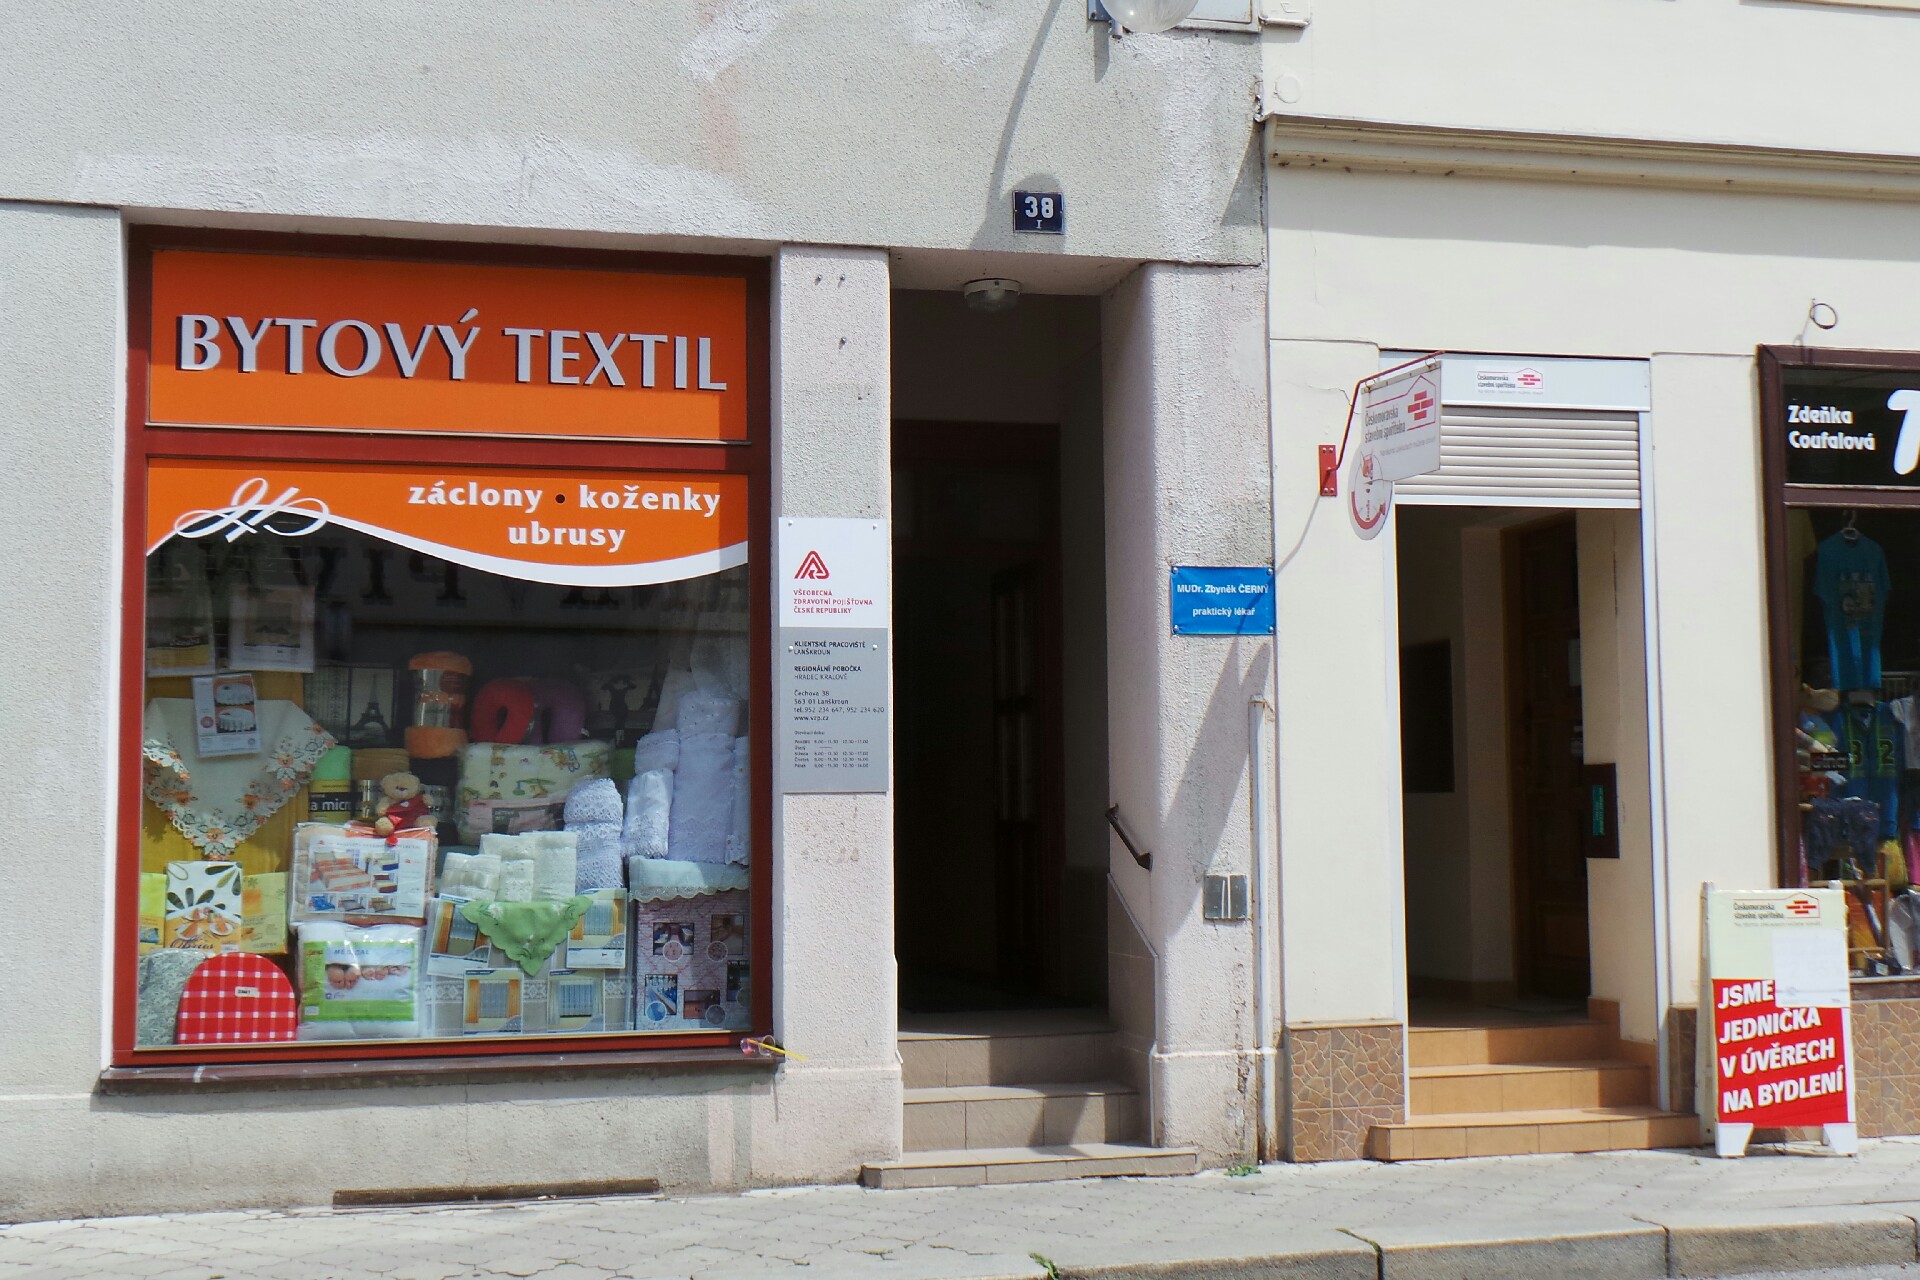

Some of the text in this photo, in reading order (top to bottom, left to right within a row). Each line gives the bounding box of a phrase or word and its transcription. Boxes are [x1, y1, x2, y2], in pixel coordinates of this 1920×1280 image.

[1025, 196, 1054, 219] 38
[176, 308, 728, 389] BYTOVÝ TEXTIL
[1788, 404, 1853, 424] Zdeňka
[1788, 430, 1876, 450] Coufalová
[408, 480, 543, 513] záclony
[579, 484, 721, 517] koženky
[507, 520, 626, 552] ubrusy
[1176, 583, 1269, 595] MUDr. Zbyněk ČERNÝ
[793, 606, 814, 614] ČESKÉ
[1192, 607, 1256, 618] praktický lékař
[1717, 980, 1774, 1009] JSME
[1719, 1007, 1822, 1044] JEDNIČKA
[1720, 1037, 1836, 1078] V ÚVĚRECH
[1723, 1064, 1844, 1113] NA BYDLENÍ
